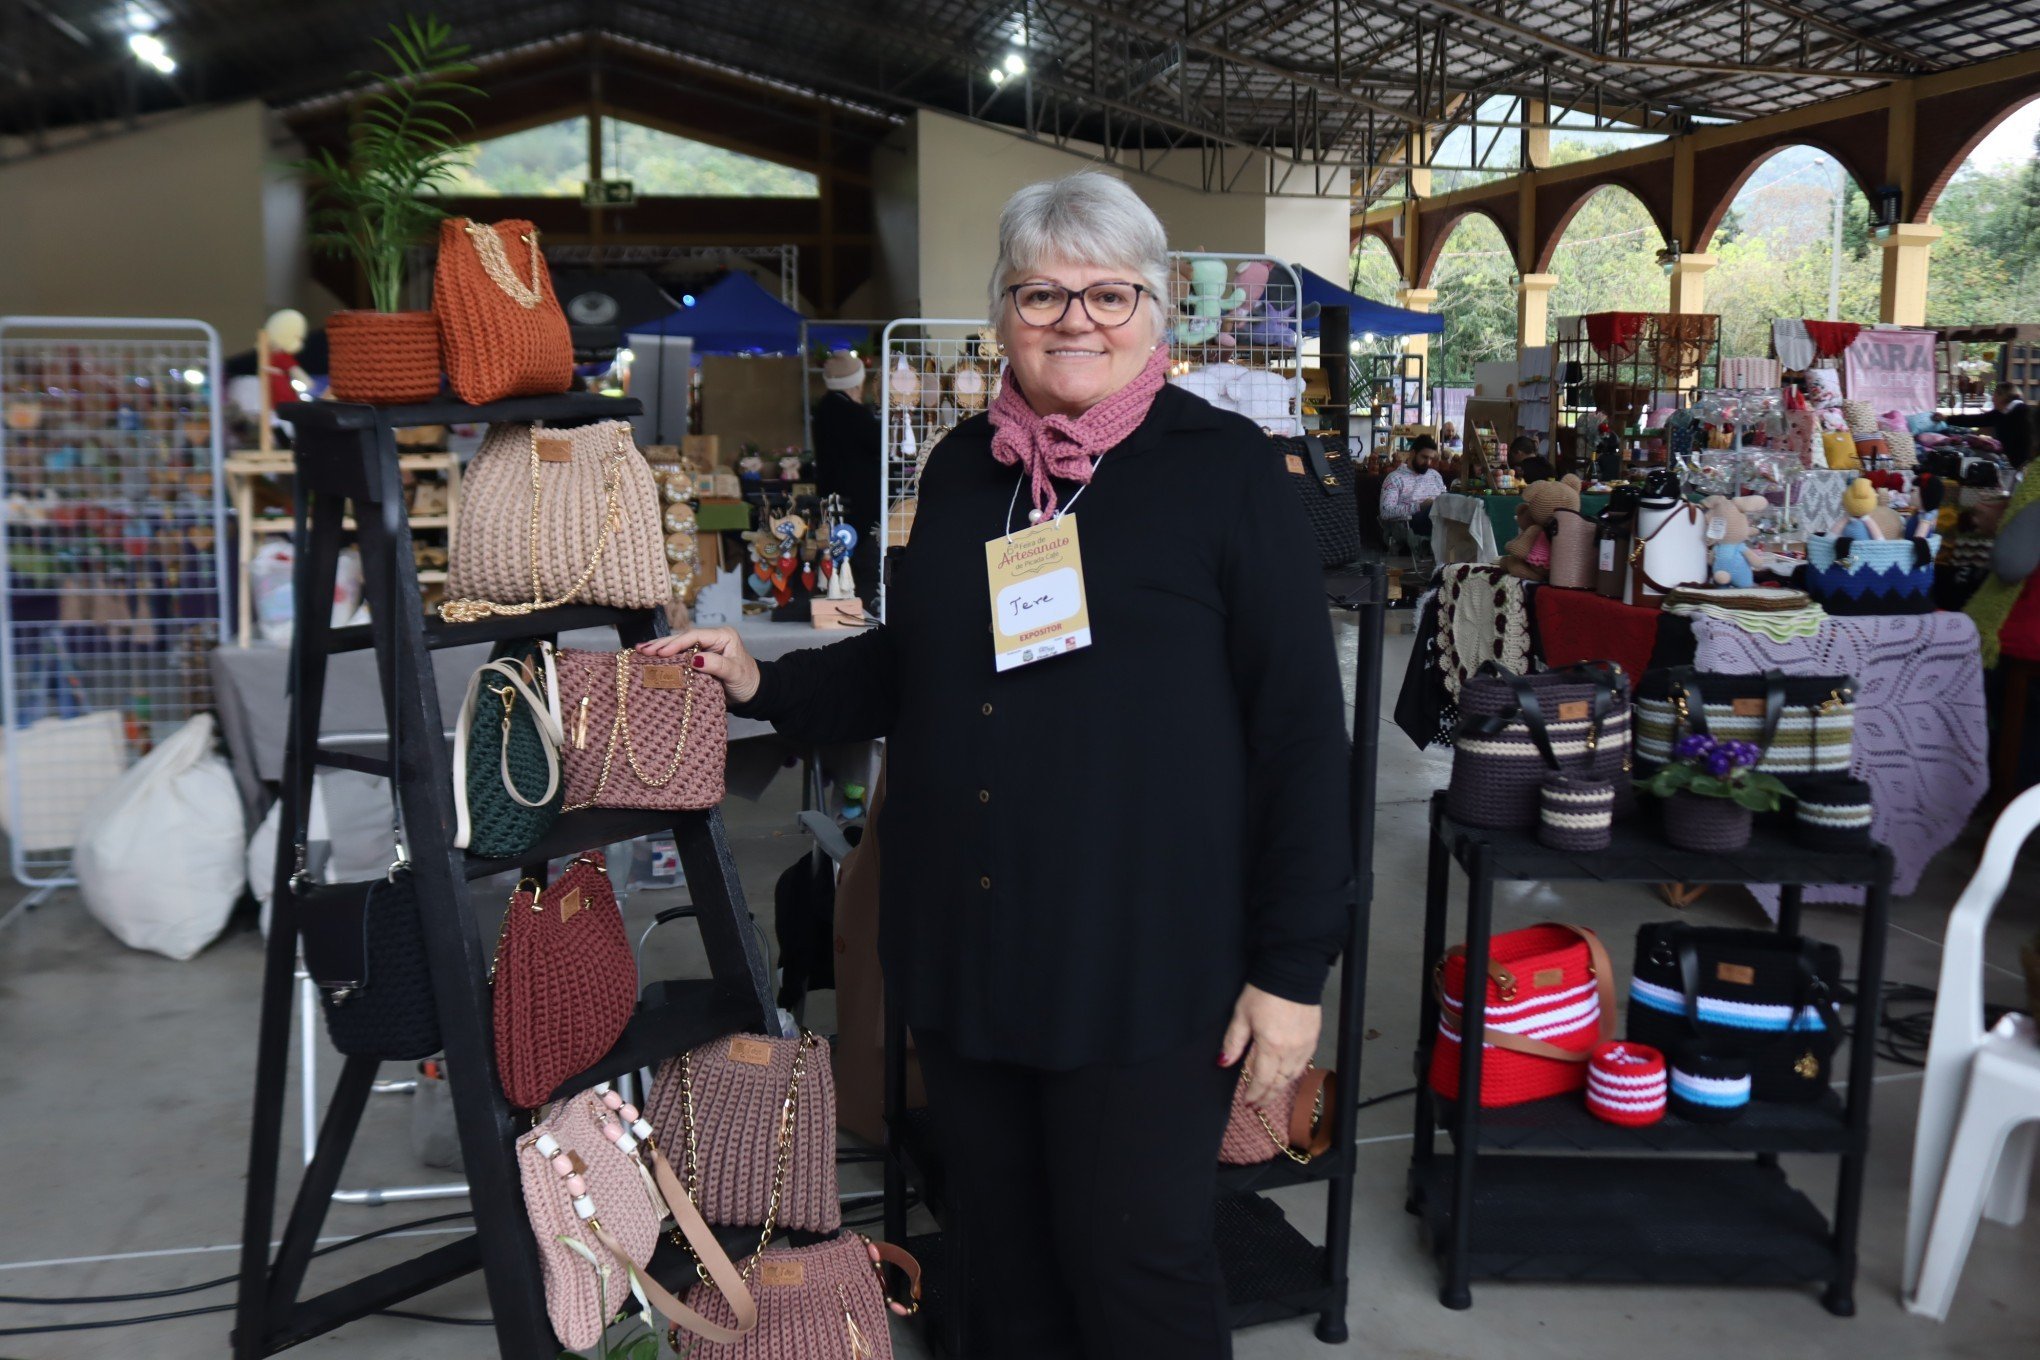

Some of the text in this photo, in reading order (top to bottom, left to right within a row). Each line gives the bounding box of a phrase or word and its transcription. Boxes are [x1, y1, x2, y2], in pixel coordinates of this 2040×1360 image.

[1019, 541, 1036, 550] Feira
[998, 537, 1070, 570] Artesanato
[1025, 556, 1045, 567] Picada
[1019, 623, 1063, 642] EXPOSITOR
